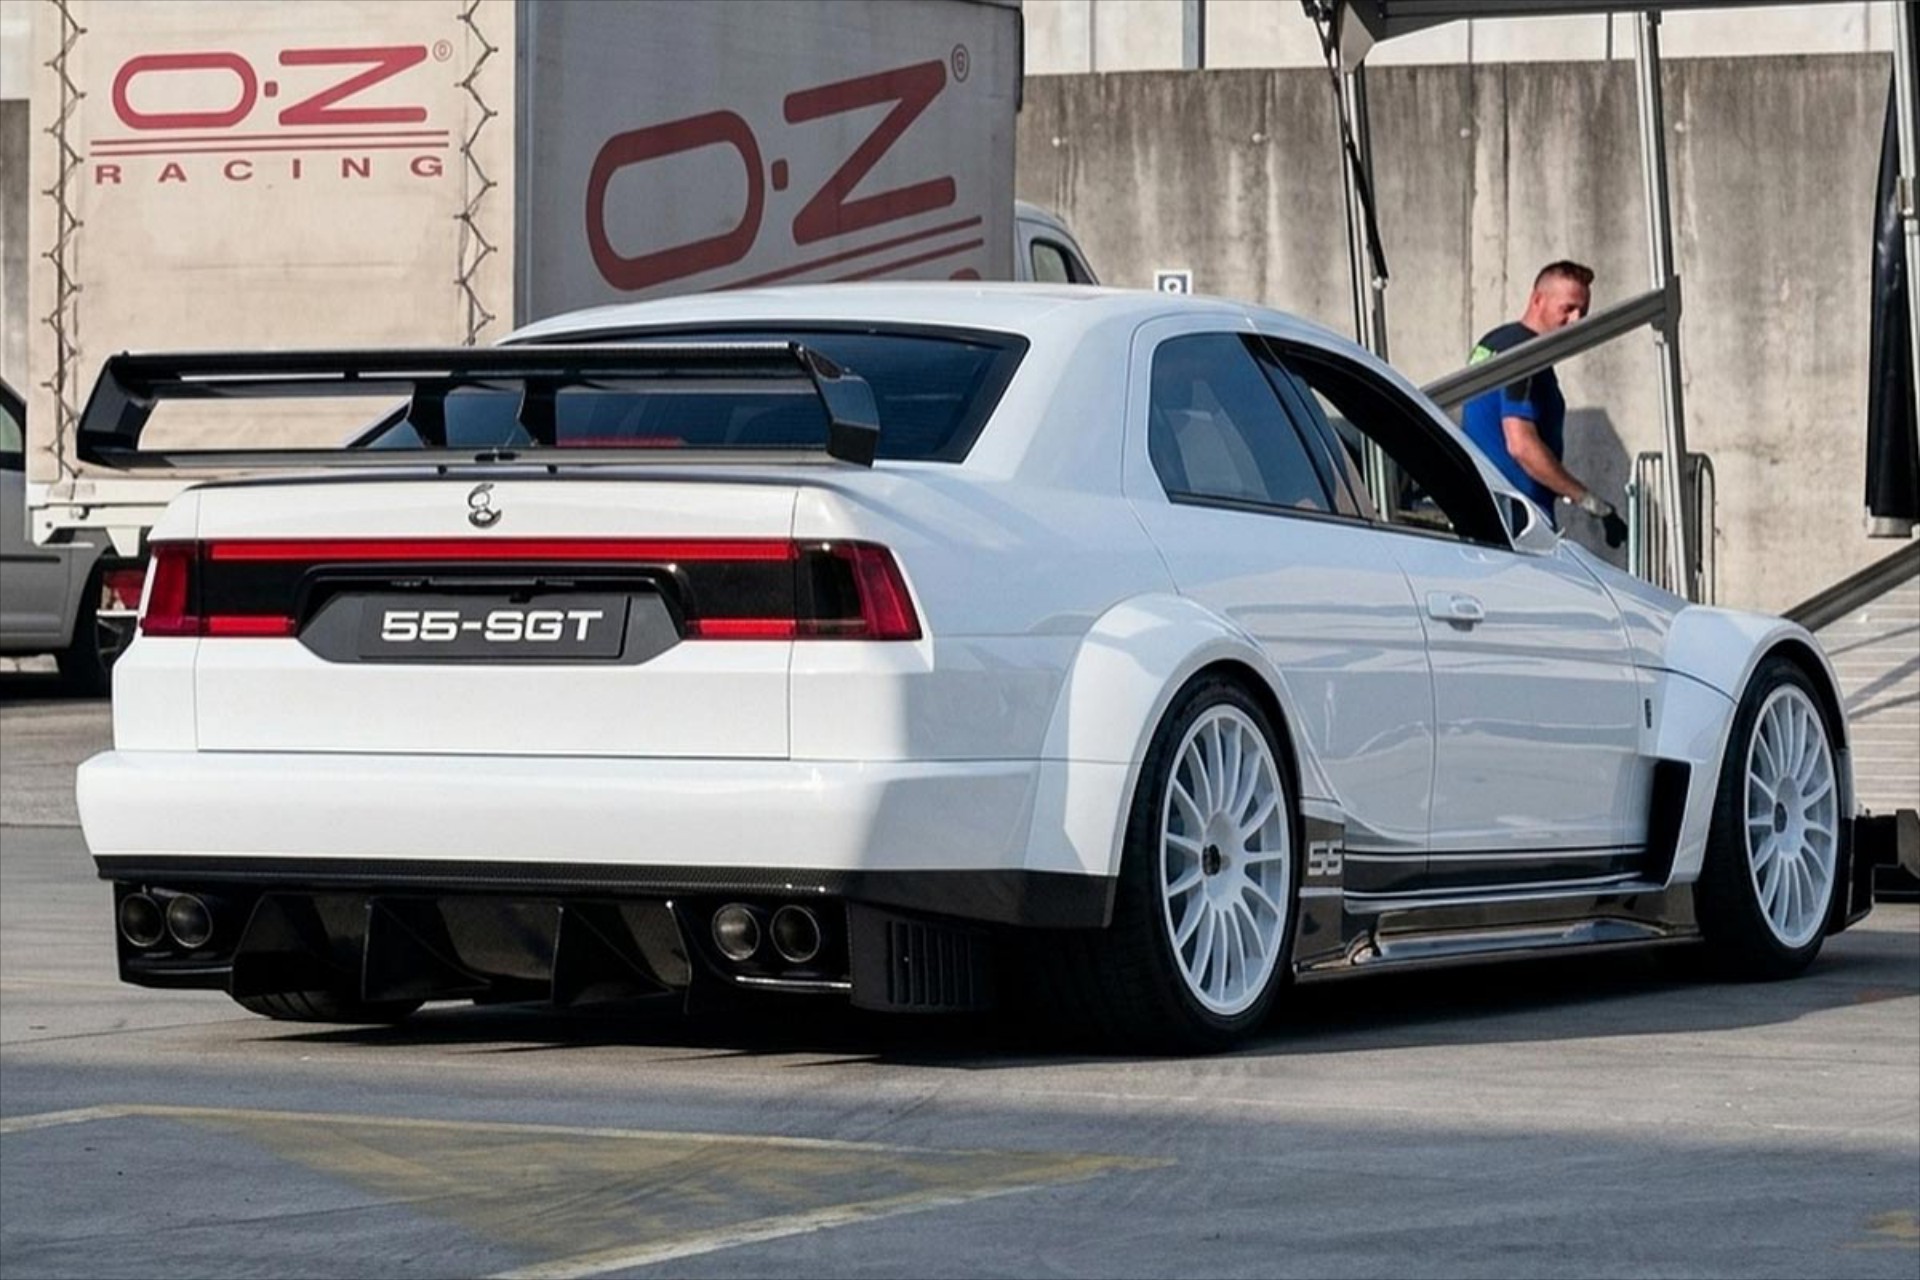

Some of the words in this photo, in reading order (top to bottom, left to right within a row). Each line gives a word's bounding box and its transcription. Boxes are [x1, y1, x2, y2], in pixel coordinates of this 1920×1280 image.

[95, 156, 443, 185] RACING
[381, 610, 603, 641] 55-SGT
[1307, 840, 1343, 876] 55
